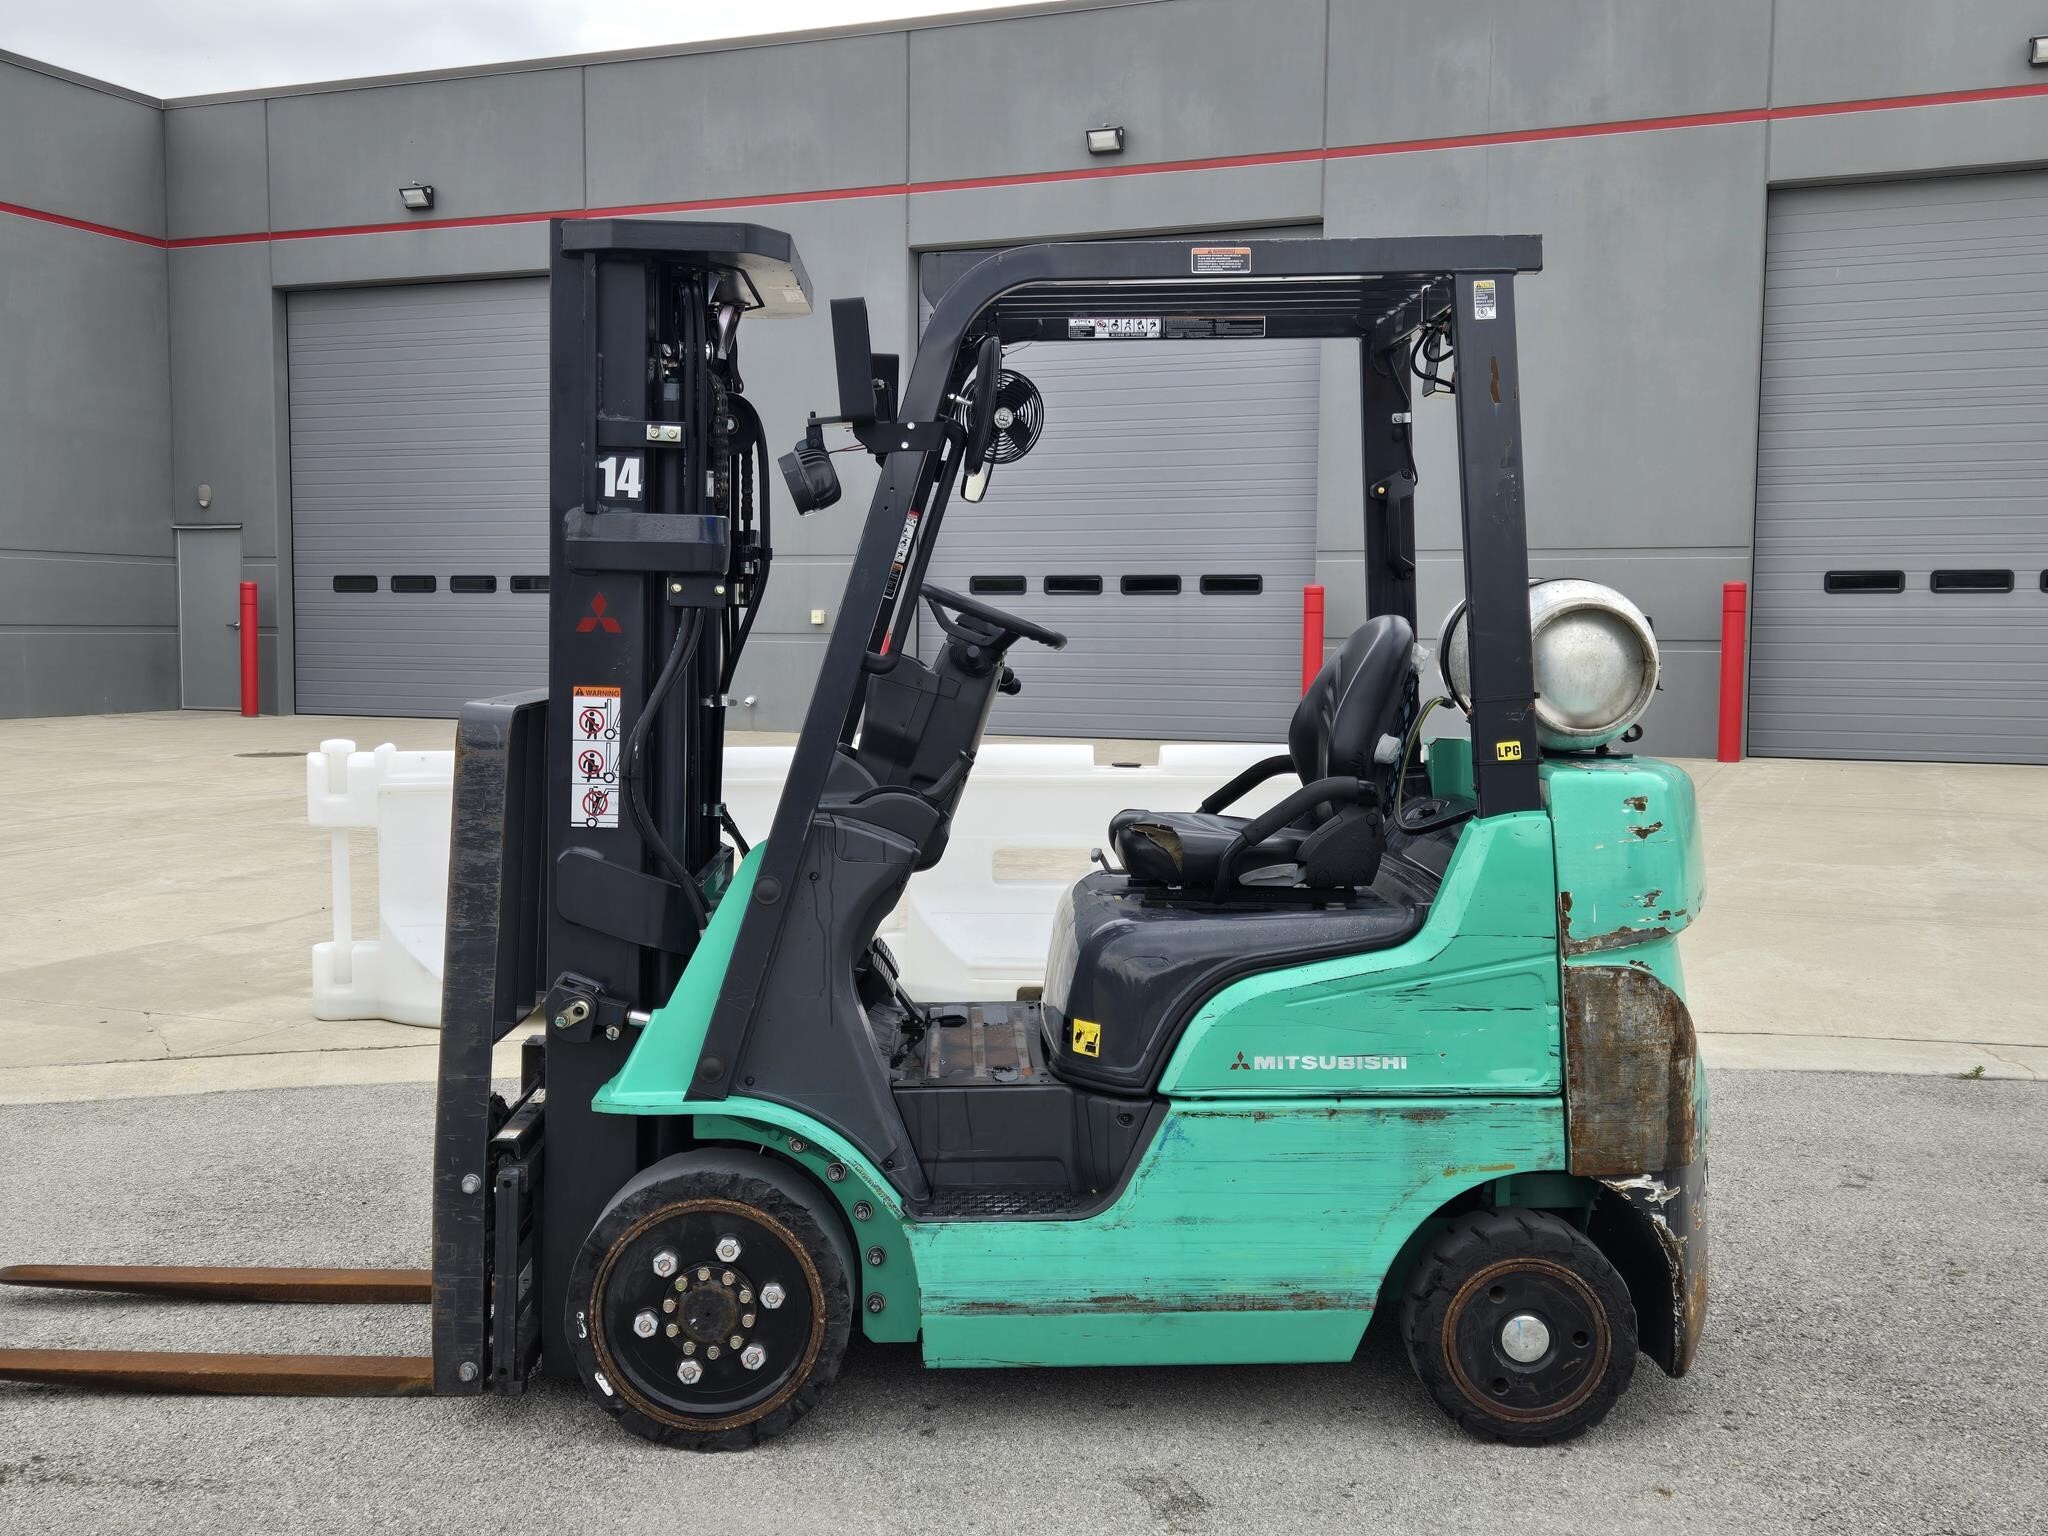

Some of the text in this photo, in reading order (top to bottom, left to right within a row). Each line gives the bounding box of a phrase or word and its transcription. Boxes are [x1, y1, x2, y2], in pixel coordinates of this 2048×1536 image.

[598, 457, 642, 498] 14
[585, 689, 620, 697] WARNING
[1497, 745, 1520, 758] LPG
[1253, 1055, 1408, 1070] MITSUBISHI
